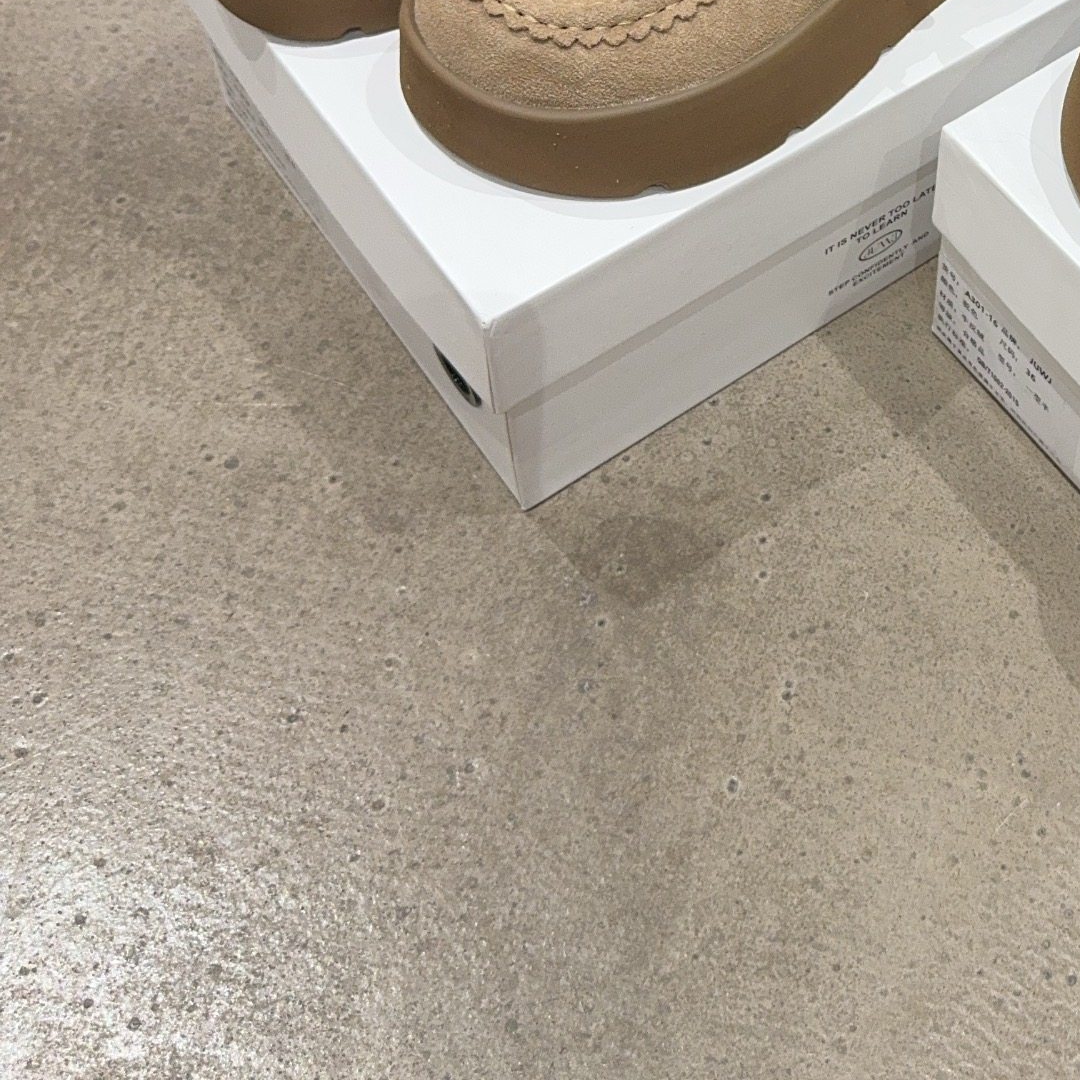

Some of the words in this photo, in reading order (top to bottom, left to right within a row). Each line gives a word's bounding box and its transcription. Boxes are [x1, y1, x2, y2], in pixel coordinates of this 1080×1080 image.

[824, 244, 835, 255] IT
[837, 237, 848, 248] IS
[851, 214, 886, 240] NEVER
[888, 200, 910, 216] TOO
[856, 232, 870, 244] TO
[872, 209, 908, 234] LEARN
[964, 290, 999, 328] A301-16
